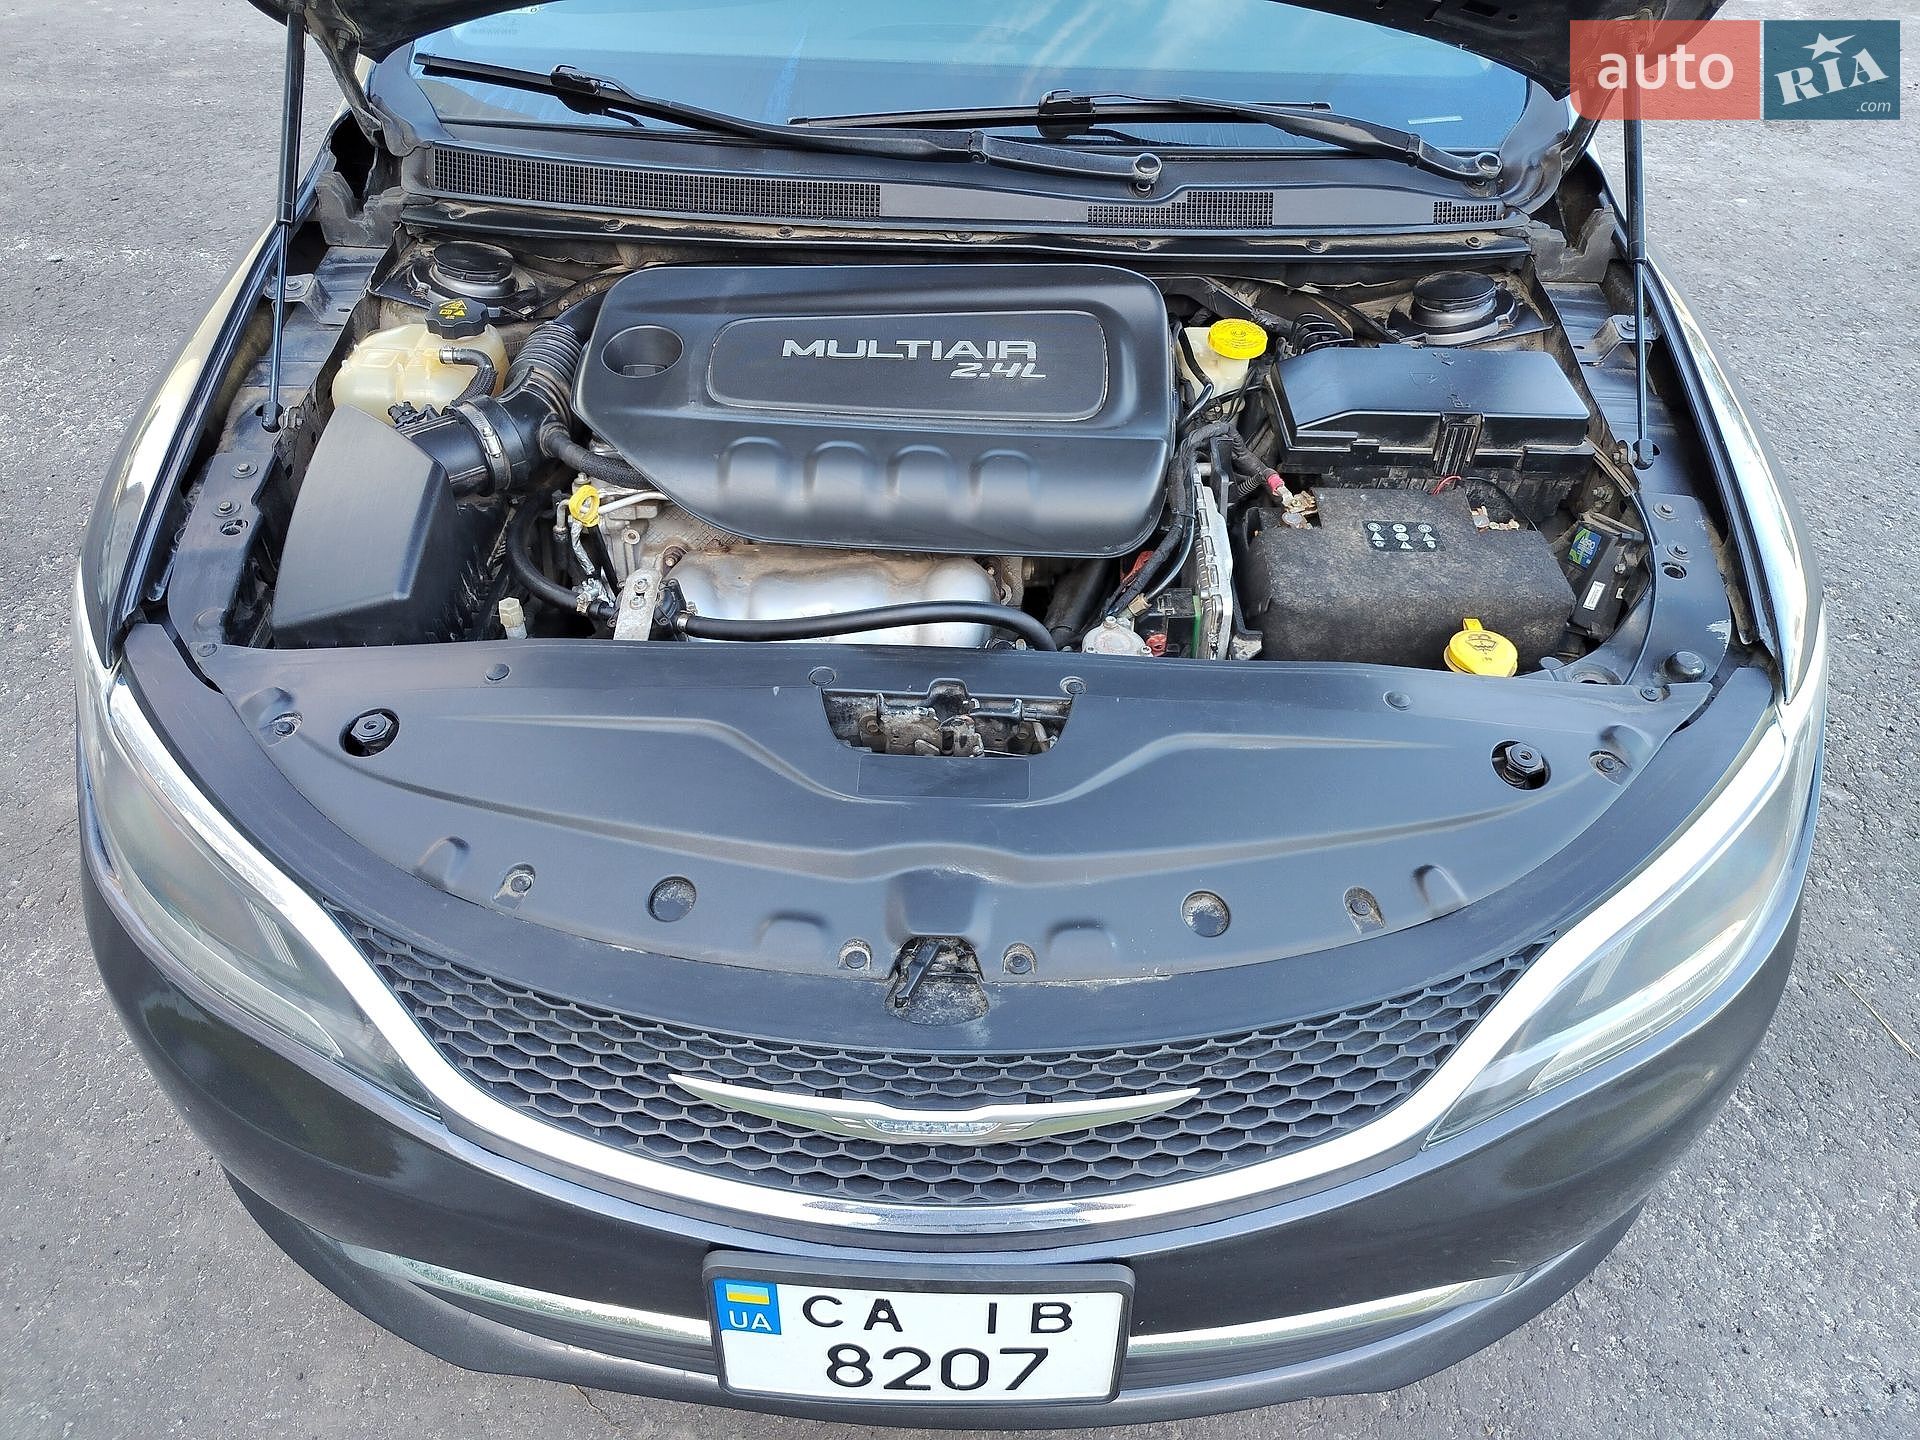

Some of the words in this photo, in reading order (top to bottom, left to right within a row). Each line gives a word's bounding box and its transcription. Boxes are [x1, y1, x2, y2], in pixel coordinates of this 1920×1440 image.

[782, 338, 1038, 361] MULTIAIR
[950, 362, 1048, 379] 2.4L
[729, 1310, 773, 1332] UA
[802, 1294, 904, 1333] CA
[986, 1301, 1074, 1334] IB
[826, 1342, 1050, 1392] 8207
